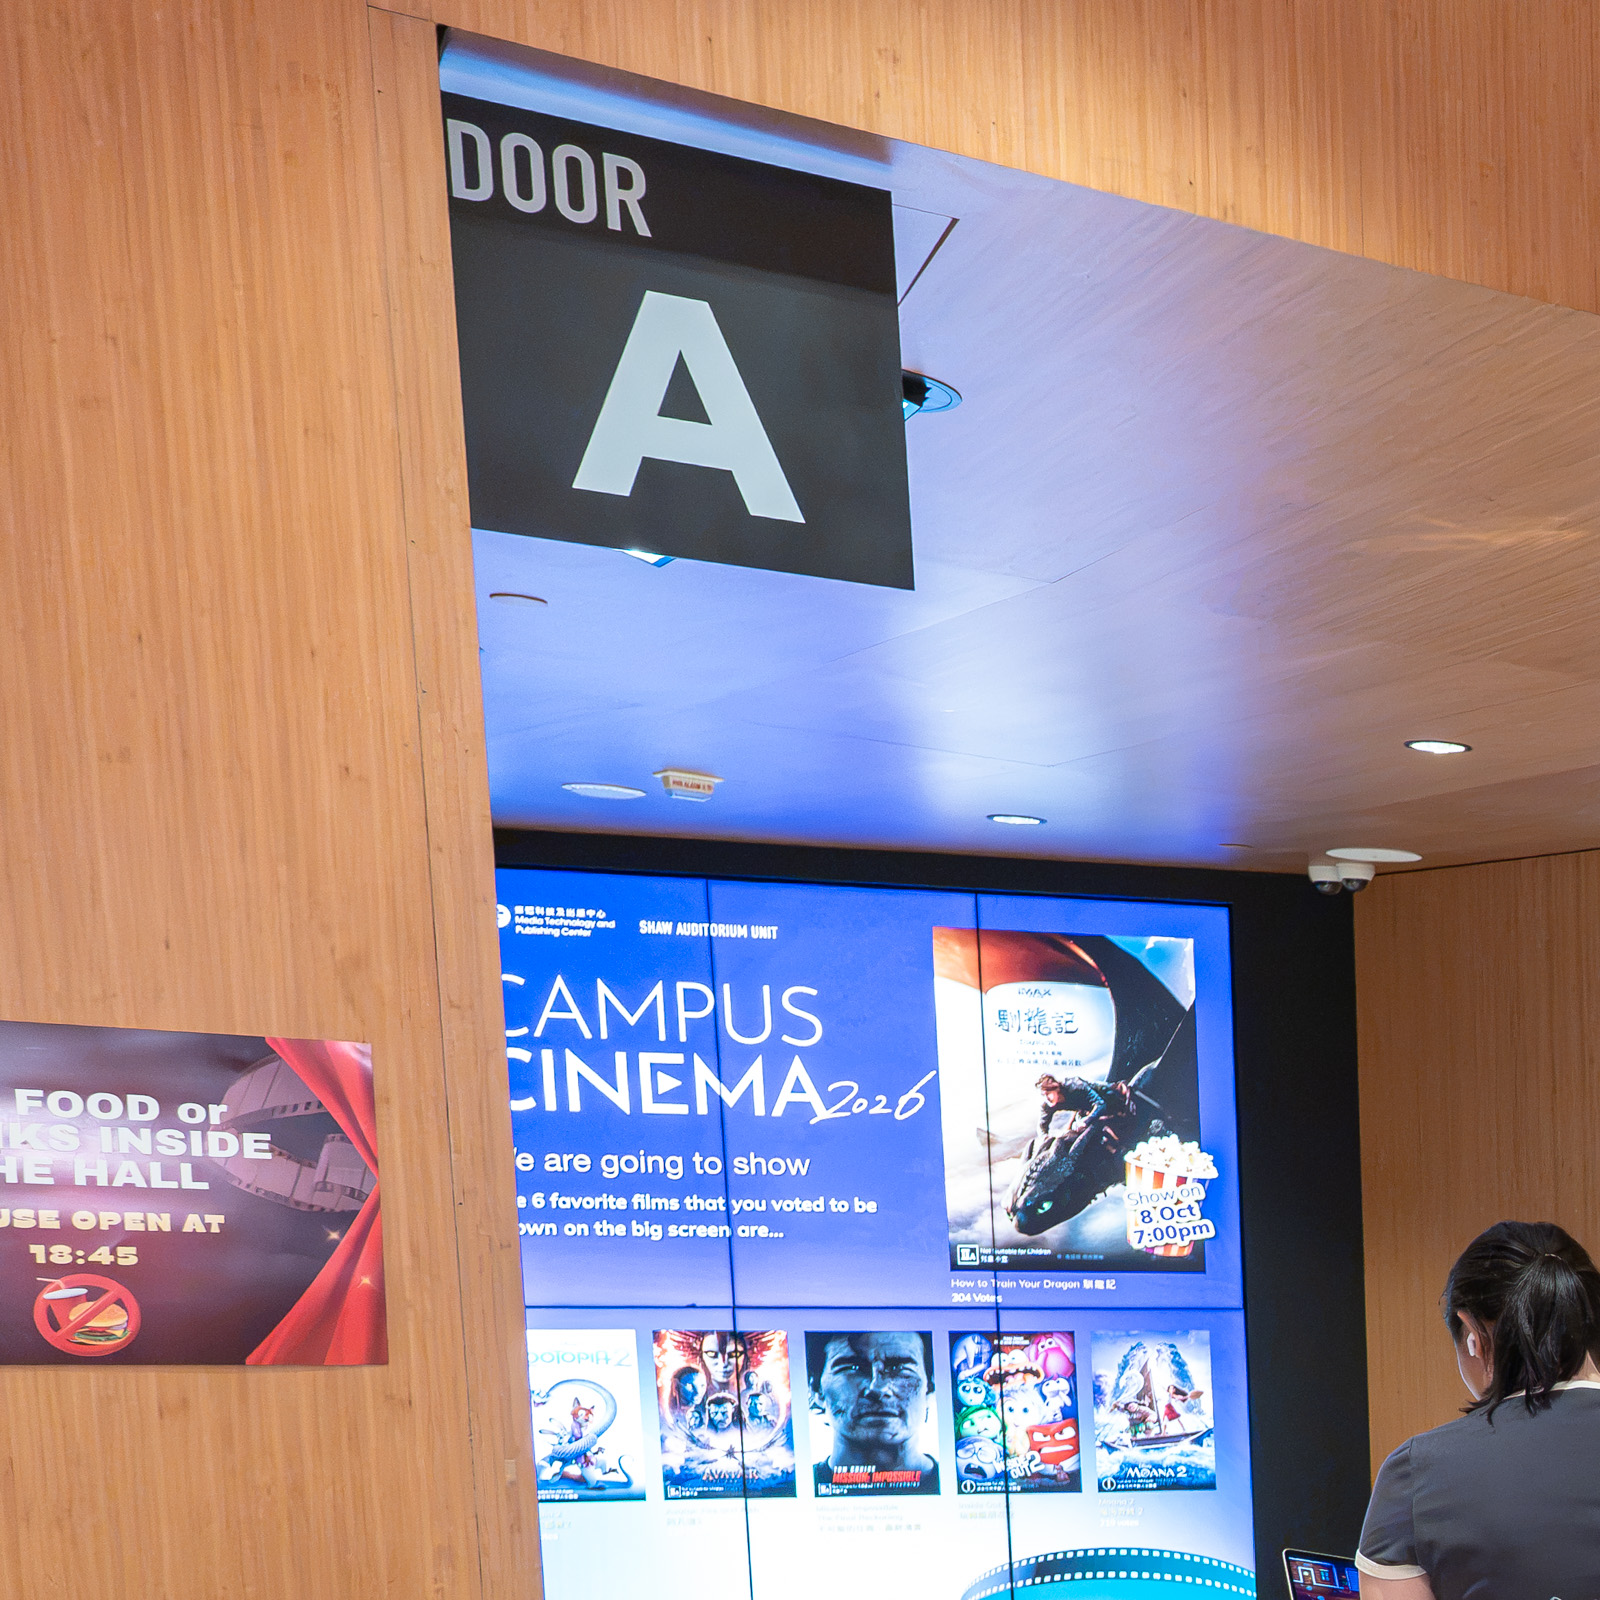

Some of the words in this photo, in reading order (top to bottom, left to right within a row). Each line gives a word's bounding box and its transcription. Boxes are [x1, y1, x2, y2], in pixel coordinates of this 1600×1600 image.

[446, 118, 652, 237] DOOR
[572, 290, 806, 524] A
[515, 915, 544, 925] Media
[545, 916, 596, 928] Technology
[597, 920, 616, 929] and
[515, 925, 560, 938] Publishing
[561, 927, 592, 937] Center
[639, 919, 673, 935] SHAW
[676, 921, 748, 938] AUDITORIUM
[751, 925, 778, 940] UNIT
[995, 1007, 1079, 1036] 馴龍記
[14, 1088, 160, 1122] FOOD
[177, 1102, 228, 1125] or
[810, 1070, 937, 1124] 2026
[0, 1122, 81, 1153] KS
[100, 1126, 273, 1160] INSIDE
[74, 1156, 210, 1190] HALL
[513, 1148, 534, 1172] e
[544, 1153, 591, 1173] are
[600, 1149, 684, 1180] going
[692, 1152, 723, 1175] to
[733, 1151, 811, 1176] show
[532, 1192, 545, 1209] 6
[549, 1191, 627, 1210] favorite
[632, 1193, 680, 1211] films
[684, 1194, 726, 1212] that
[732, 1197, 767, 1216] you
[771, 1196, 825, 1213] voted
[829, 1197, 850, 1213] to
[854, 1196, 878, 1213] be
[1127, 1190, 1175, 1206] Show
[1180, 1186, 1201, 1198] on
[71, 1210, 172, 1232] OPEN
[182, 1213, 226, 1234] AT
[1140, 1210, 1153, 1224] 8
[1160, 1204, 1196, 1221] Oct
[563, 1223, 590, 1236] on
[593, 1219, 626, 1237] the
[631, 1220, 663, 1241] big
[667, 1224, 732, 1239] screen
[737, 1224, 784, 1239] are...
[1133, 1223, 1210, 1244] 7:00pm
[29, 1244, 139, 1266] 18:45
[951, 1279, 975, 1288] How
[977, 1279, 988, 1288] to
[991, 1279, 1017, 1289] Train
[1018, 1279, 1042, 1289] Your
[1043, 1279, 1081, 1291] Dragon
[1025, 1450, 1045, 1473] 2
[1126, 1466, 1176, 1479] MOANA
[1176, 1465, 1187, 1478] 2
[872, 1471, 922, 1483] IMPOSSIBLE
